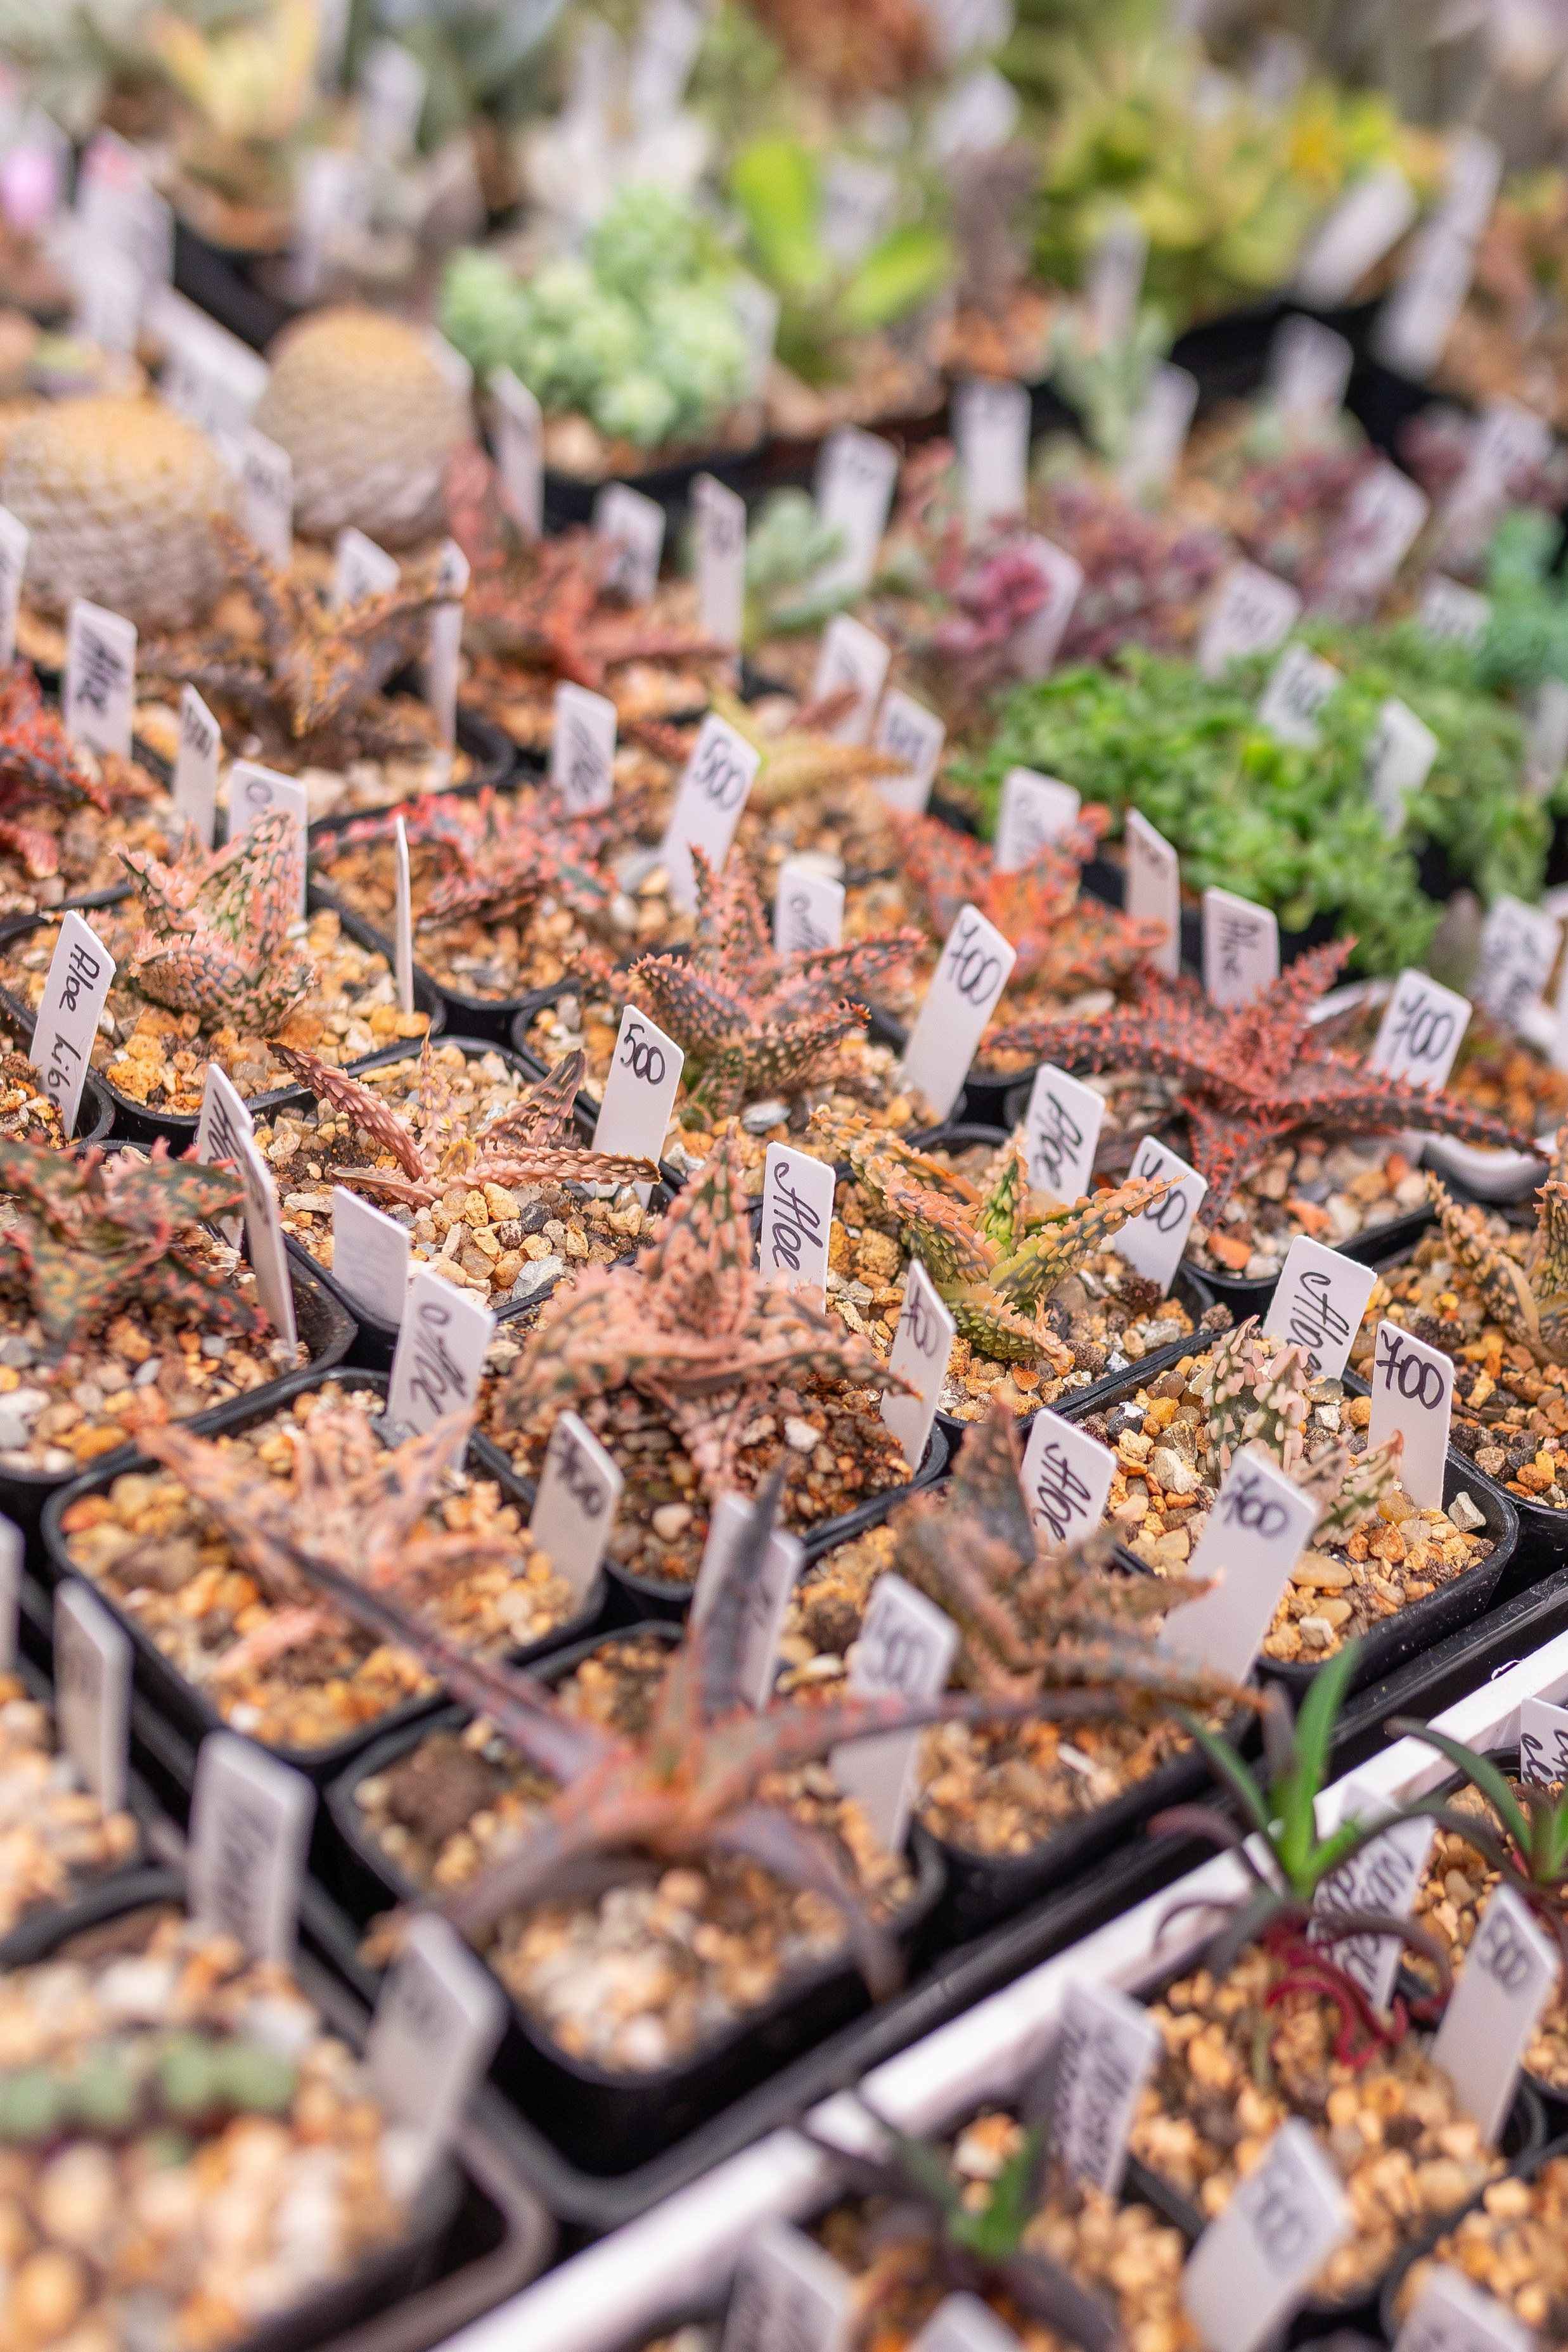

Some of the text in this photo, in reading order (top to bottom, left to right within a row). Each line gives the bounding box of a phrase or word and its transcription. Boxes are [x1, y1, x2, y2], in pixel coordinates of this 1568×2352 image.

[695, 735, 747, 811] 500
[58, 943, 100, 1012] Aloe
[620, 1023, 665, 1085] 500
[1031, 1091, 1081, 1192] Aloe
[773, 1162, 824, 1271] Aloe
[1038, 1443, 1091, 1541] Aloe
